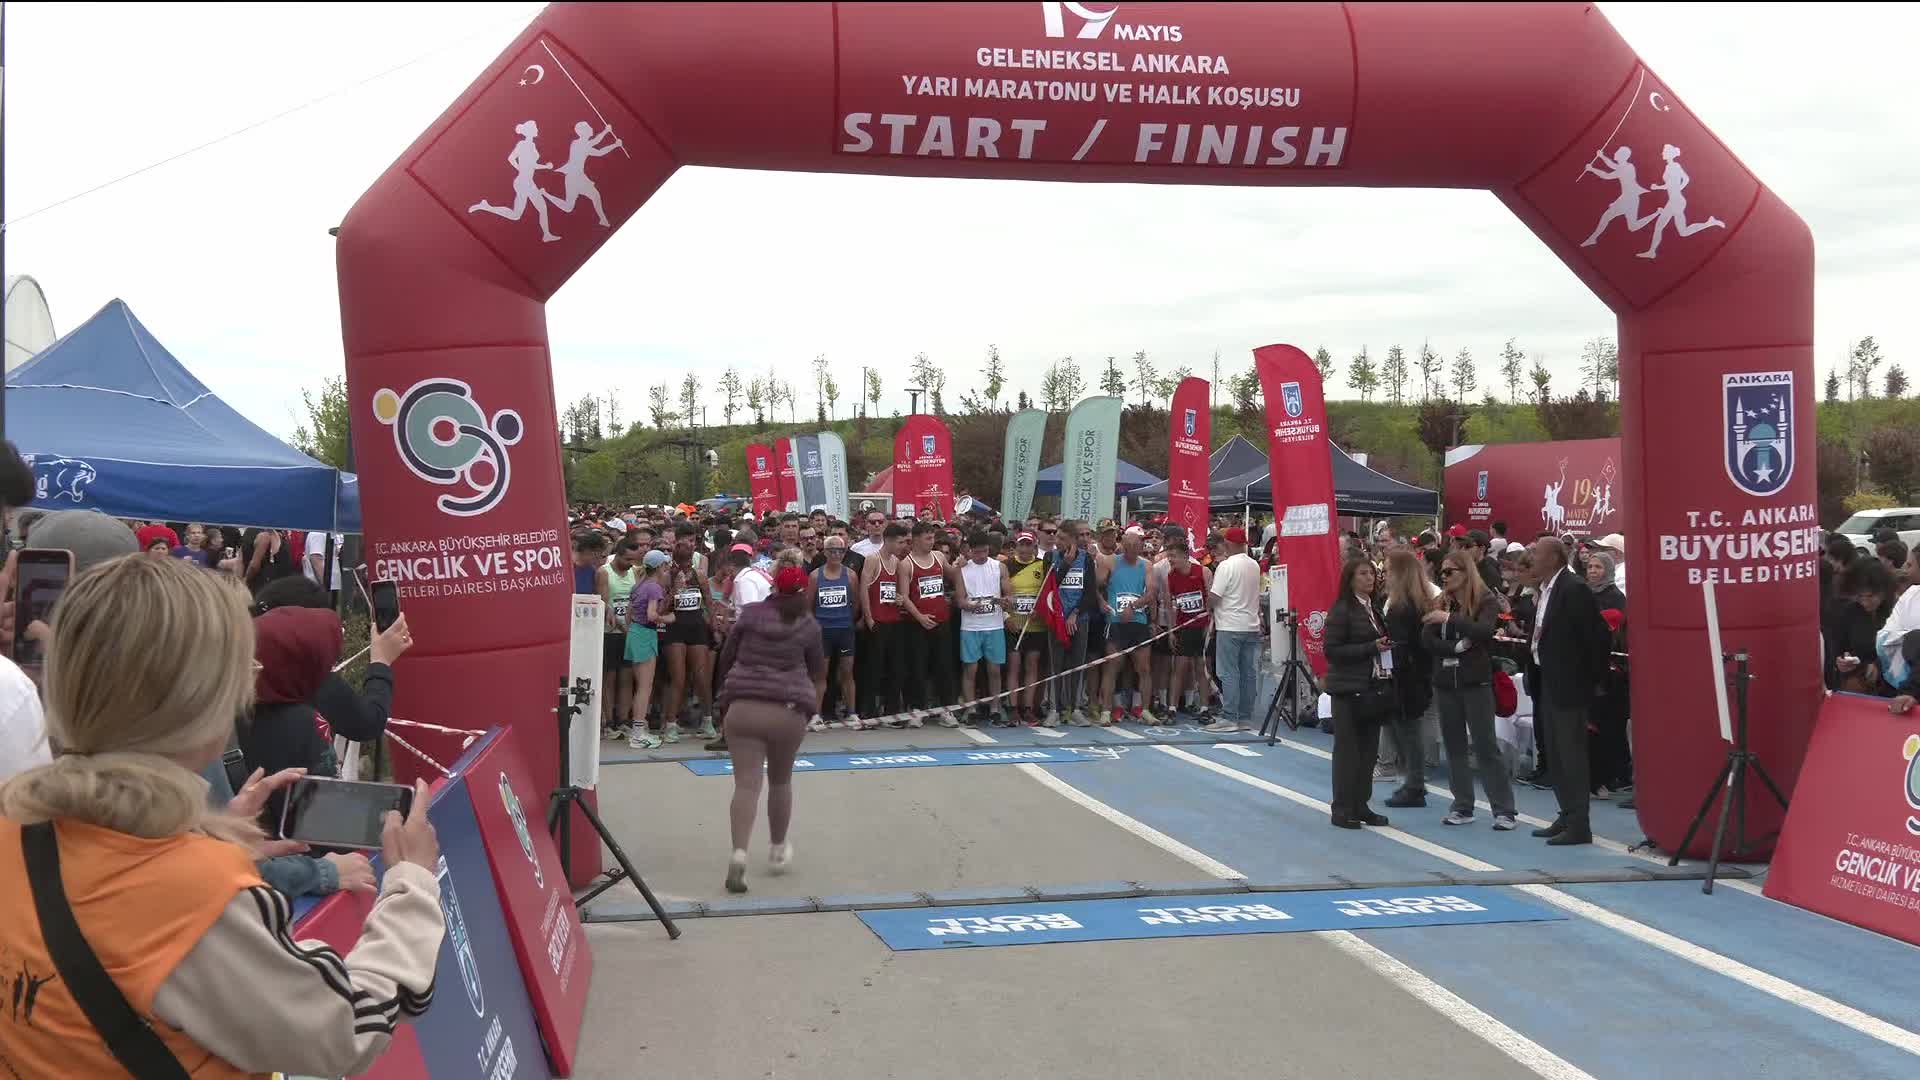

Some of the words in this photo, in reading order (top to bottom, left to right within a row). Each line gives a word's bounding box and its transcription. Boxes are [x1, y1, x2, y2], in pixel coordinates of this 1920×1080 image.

[1114, 24, 1182, 42] MAYIS
[977, 47, 1124, 72] GELENEKSEL
[1132, 53, 1229, 75] ANKARA
[902, 75, 957, 97] YARI
[965, 78, 1096, 102] MARATONU
[1104, 83, 1132, 103] VE
[1138, 86, 1201, 106] HALK
[1208, 88, 1301, 111] KOŞUSU
[843, 113, 1047, 160] START
[1073, 119, 1107, 160] /
[1135, 123, 1348, 167] FINISH
[1727, 374, 1791, 384] ANKARA
[1084, 430, 1095, 458] SPOR
[1572, 479, 1591, 505] 19
[1687, 511, 1731, 528] T.C.
[1742, 504, 1815, 526] ANKARA
[391, 541, 437, 553] ANKARA
[439, 532, 511, 552] BÜYÜKŞEHİR
[473, 552, 508, 576] VE
[513, 546, 562, 573] SPOR
[444, 577, 497, 596] DAİRESİ
[501, 570, 565, 592] BAŞKANLIĞI
[1688, 560, 1816, 585] BELEDİYESİ
[923, 584, 941, 593] 2537
[823, 596, 842, 604] 2807
[1860, 838, 1890, 855] ANKARA
[1136, 904, 1282, 917] ROLL
[1331, 896, 1469, 908] ROLL
[928, 913, 1073, 927] ROLL
